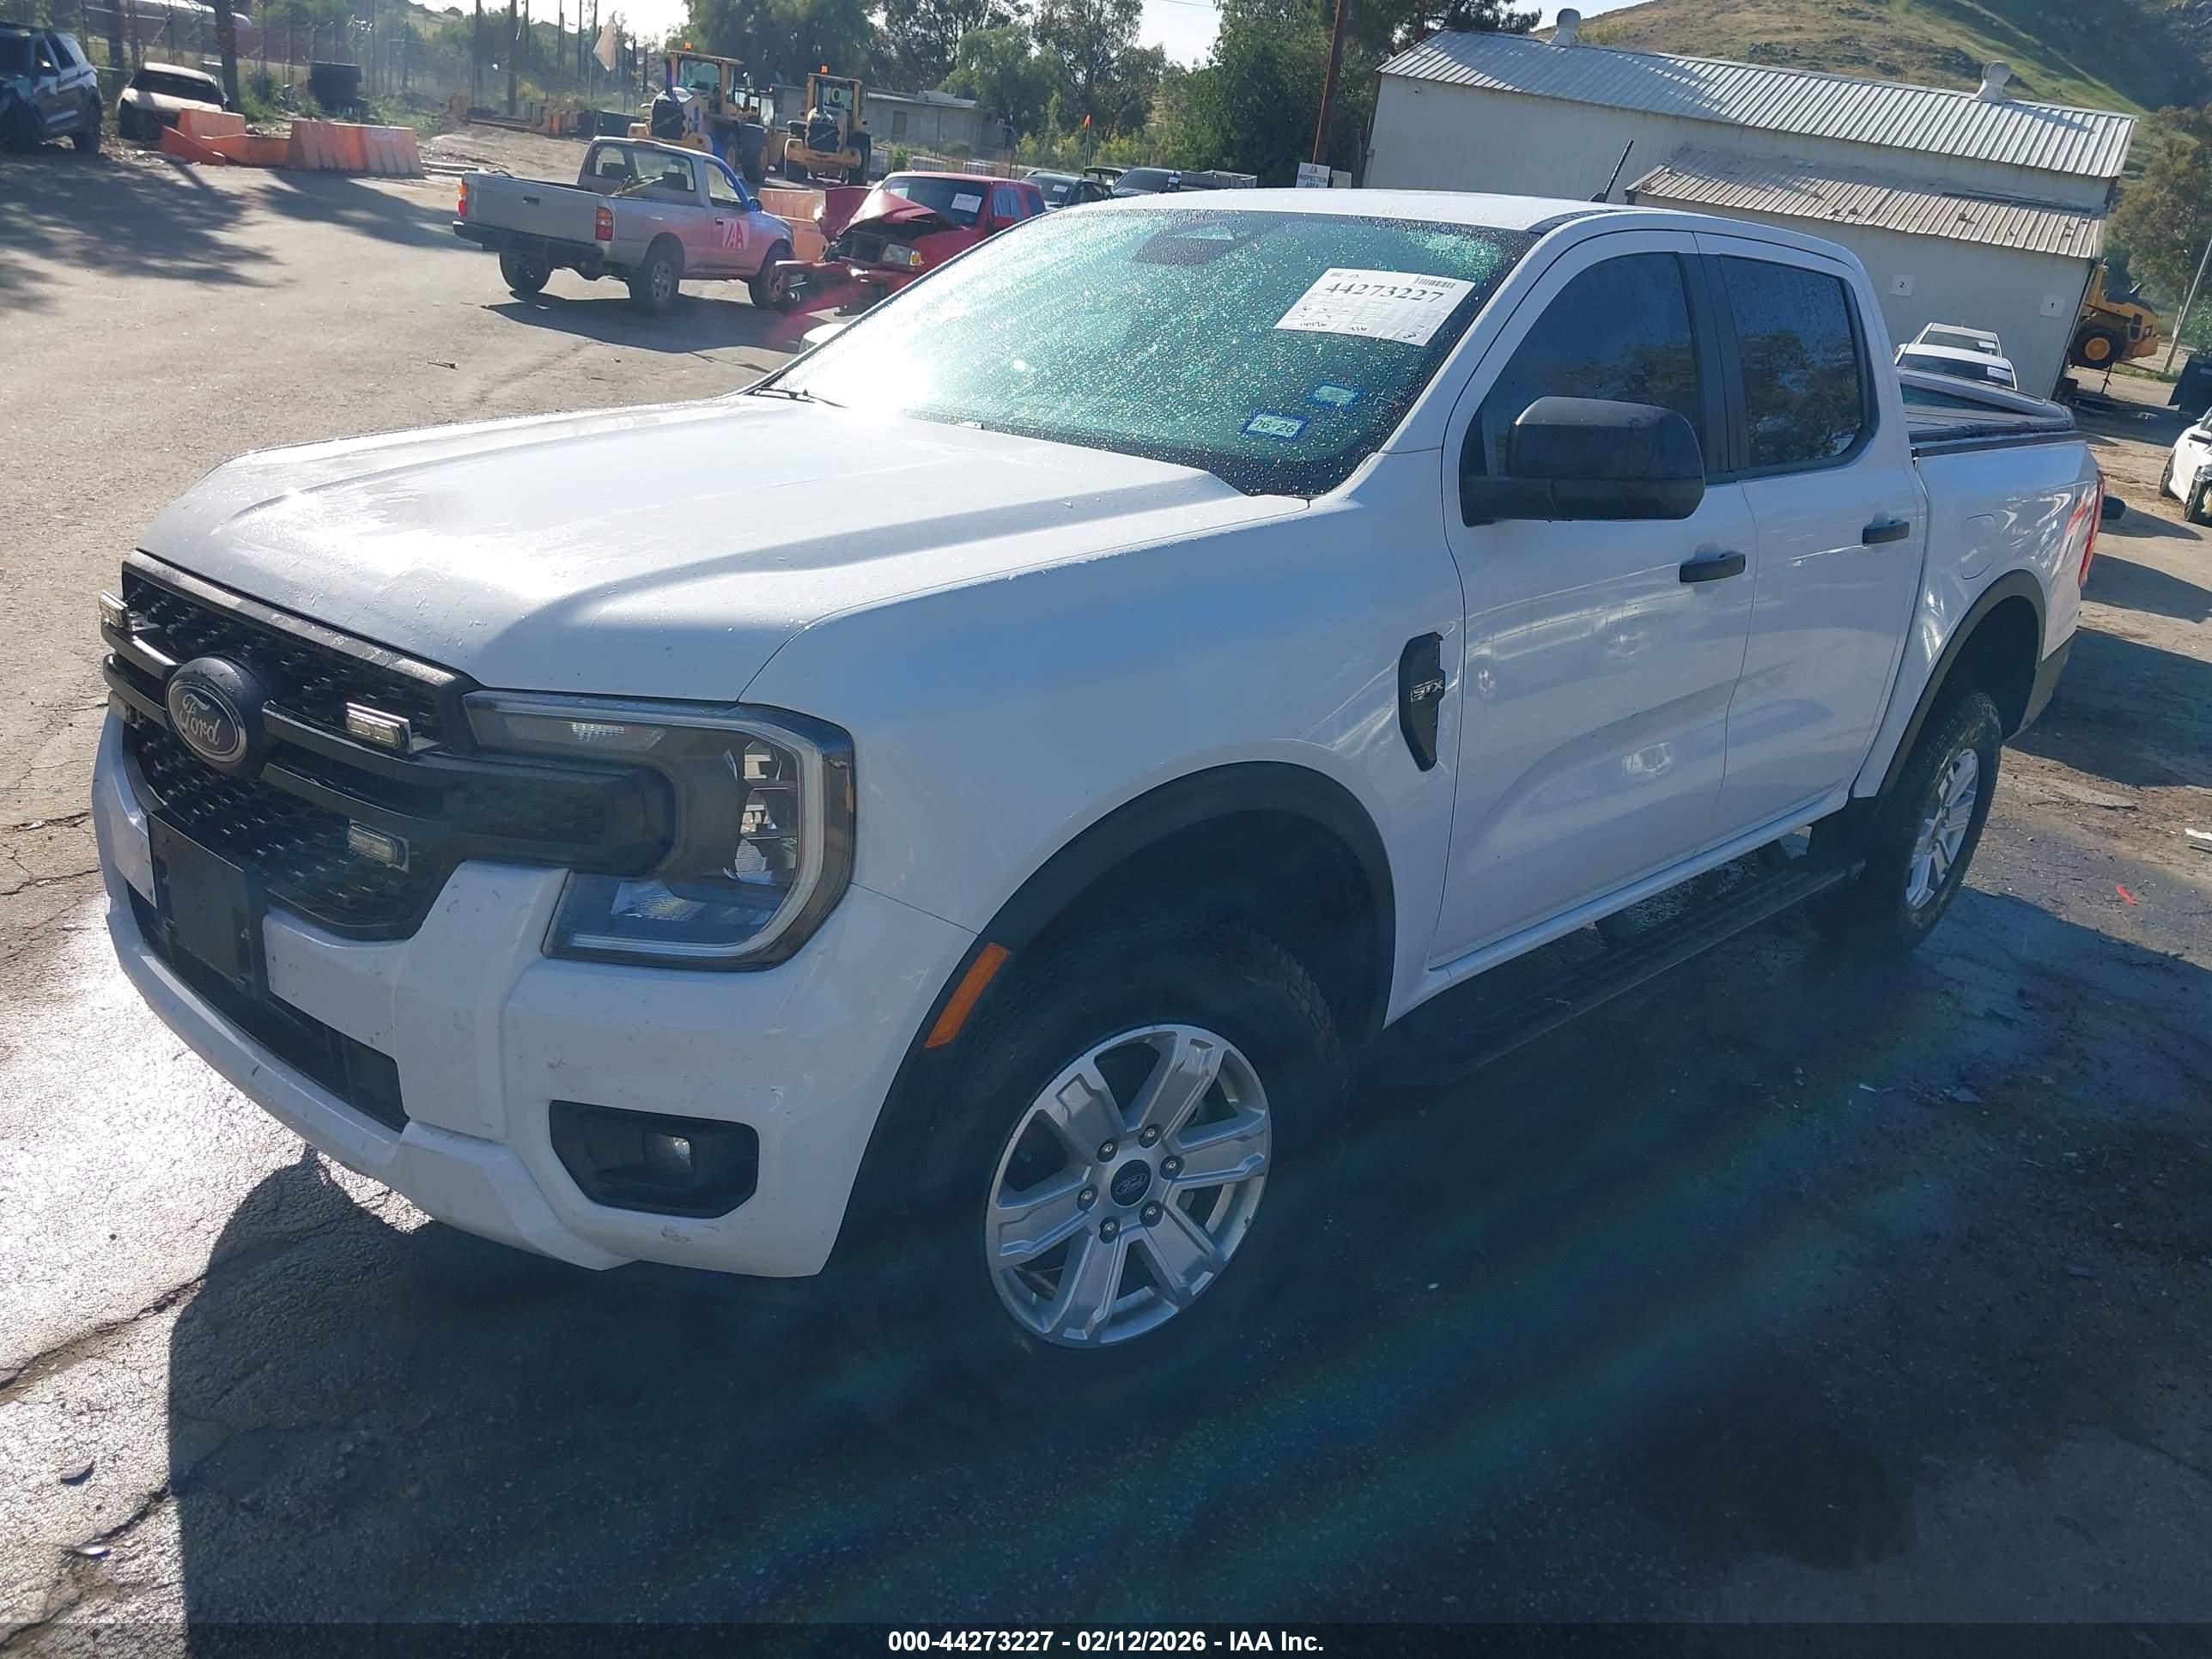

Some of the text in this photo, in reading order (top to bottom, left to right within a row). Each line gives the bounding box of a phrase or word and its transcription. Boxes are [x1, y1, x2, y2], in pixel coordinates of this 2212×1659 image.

[1298, 173, 1328, 184] INSPECTION
[1325, 283, 1444, 303] 44273227
[179, 693, 221, 745] Ford
